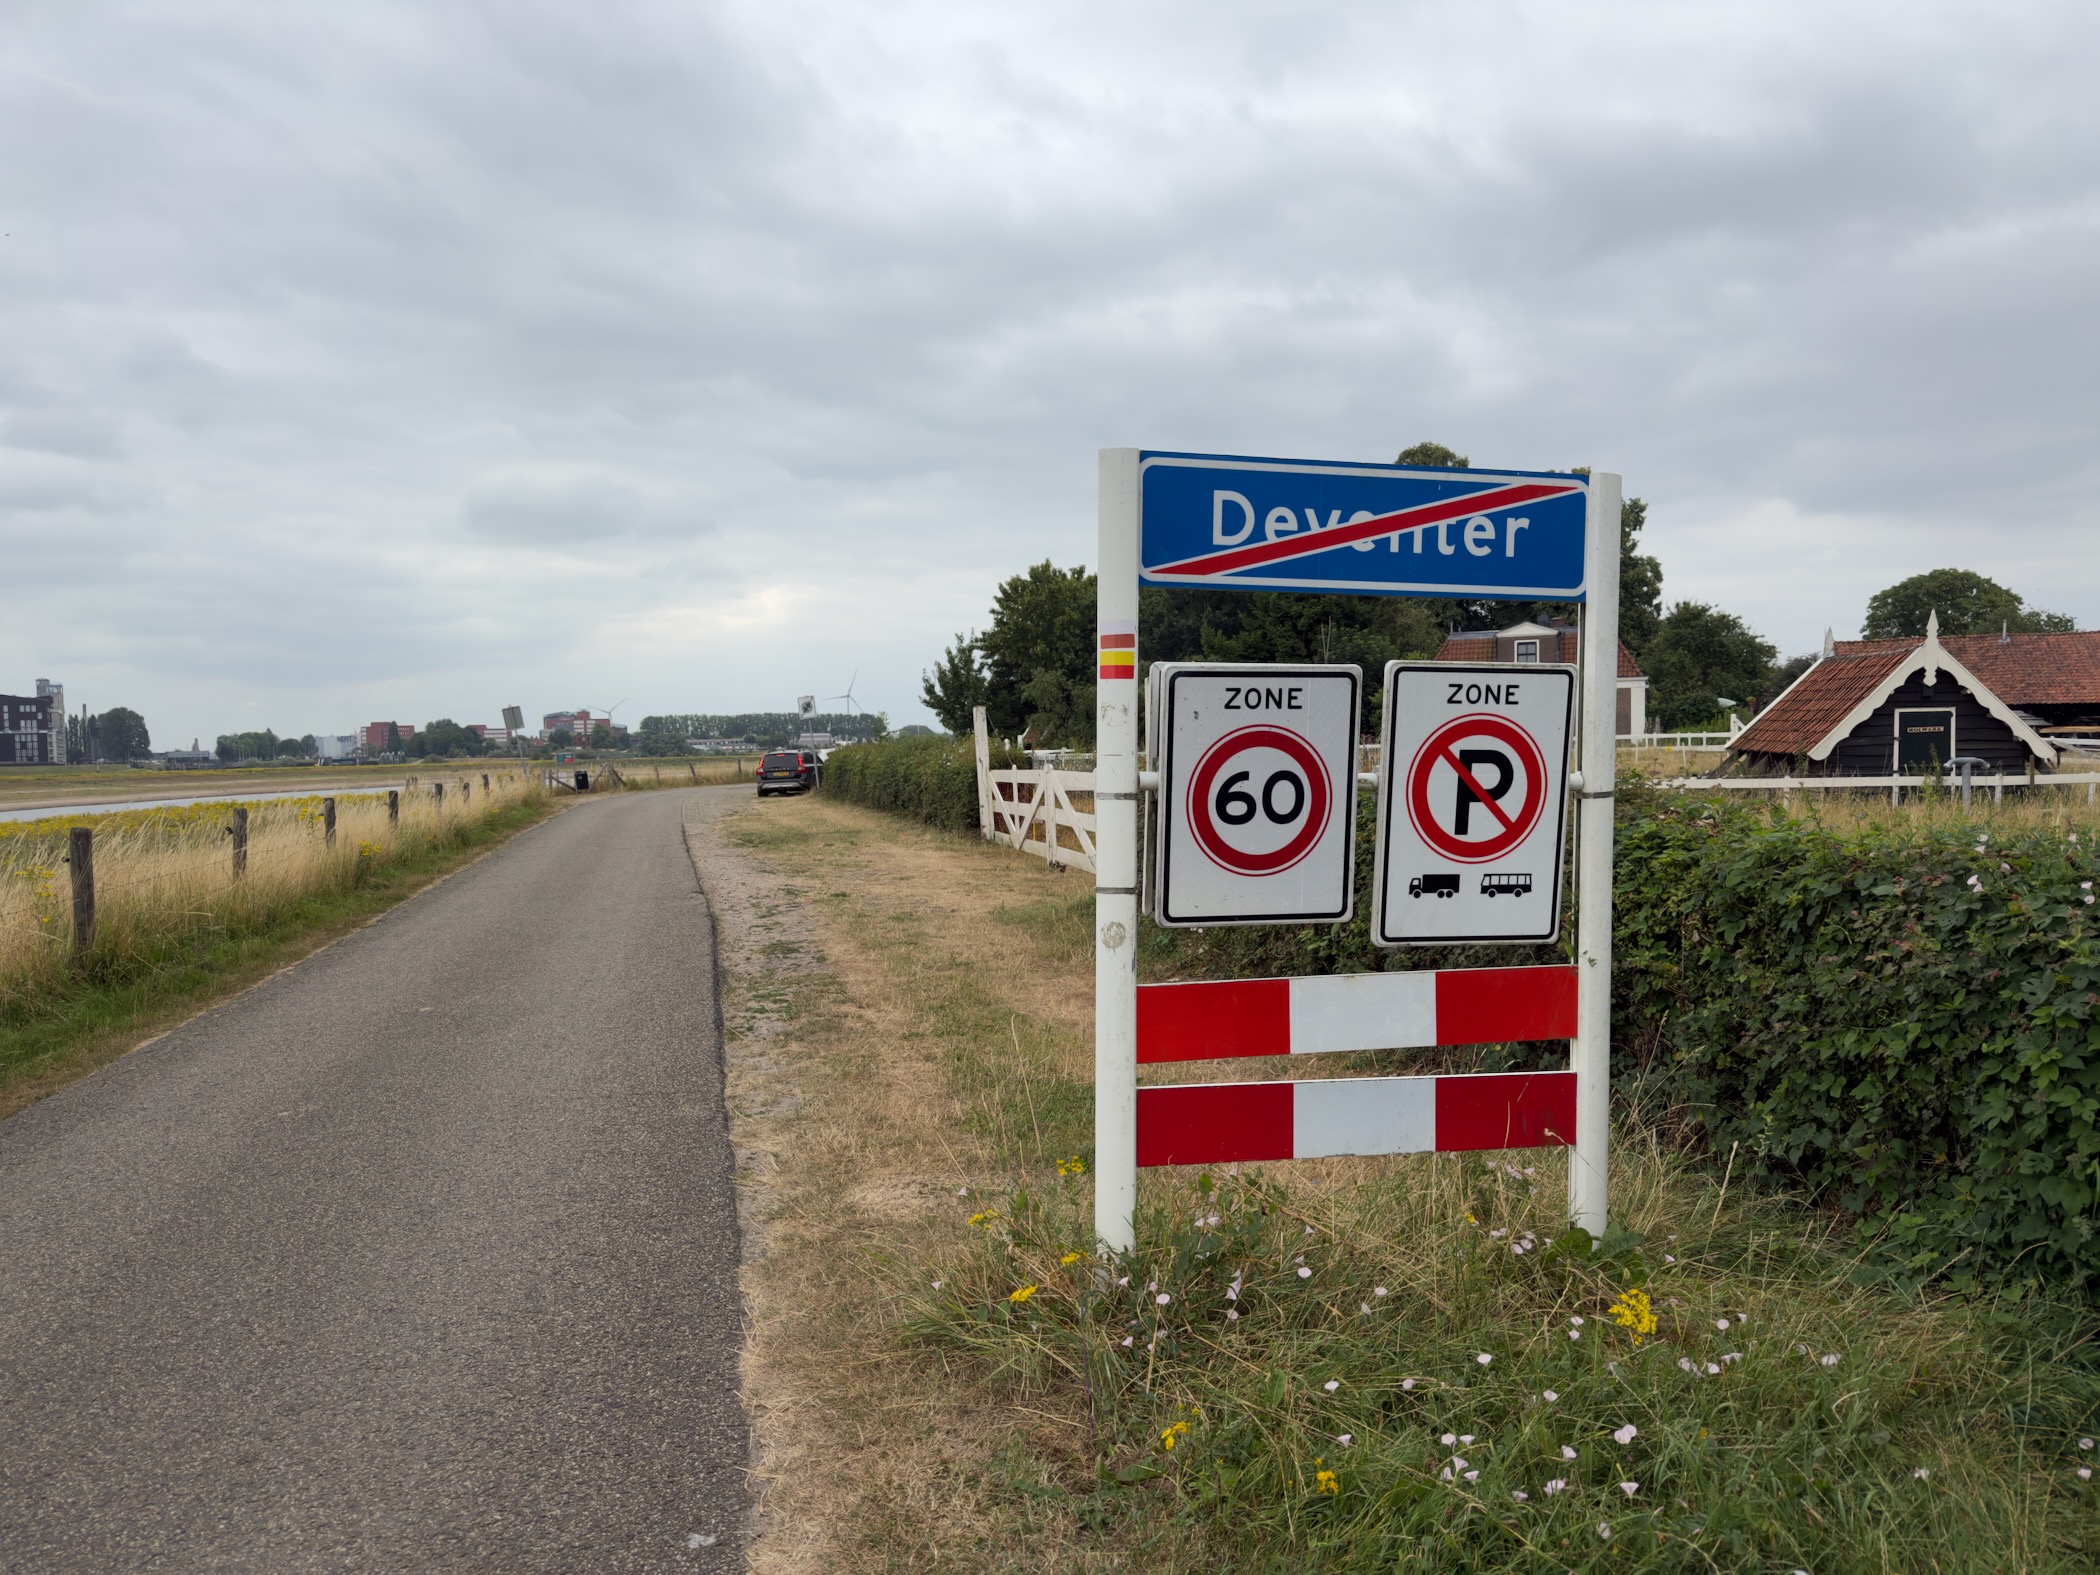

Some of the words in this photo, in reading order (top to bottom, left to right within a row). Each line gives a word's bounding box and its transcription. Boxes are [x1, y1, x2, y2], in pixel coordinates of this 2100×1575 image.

[1225, 688, 1304, 709] ZONE
[1447, 683, 1519, 705] ZONE
[1215, 770, 1305, 825] 60
[1454, 749, 1514, 836] P
